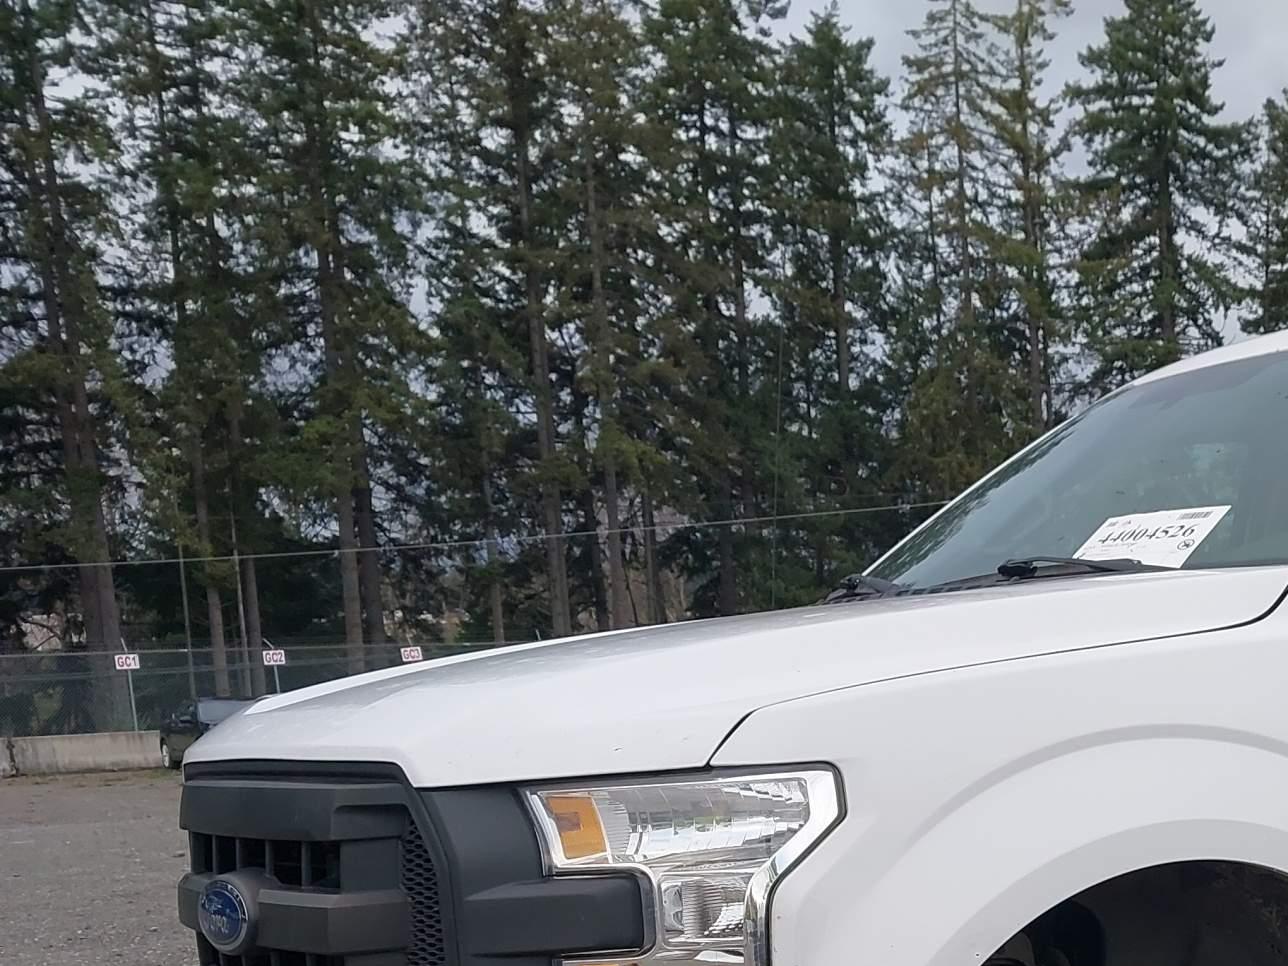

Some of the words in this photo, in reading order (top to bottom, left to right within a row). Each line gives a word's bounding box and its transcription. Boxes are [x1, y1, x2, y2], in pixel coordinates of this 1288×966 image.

[1099, 523, 1201, 544] 44004526
[265, 652, 283, 663] GC2
[403, 648, 420, 660] GC3
[117, 655, 137, 667] GC1
